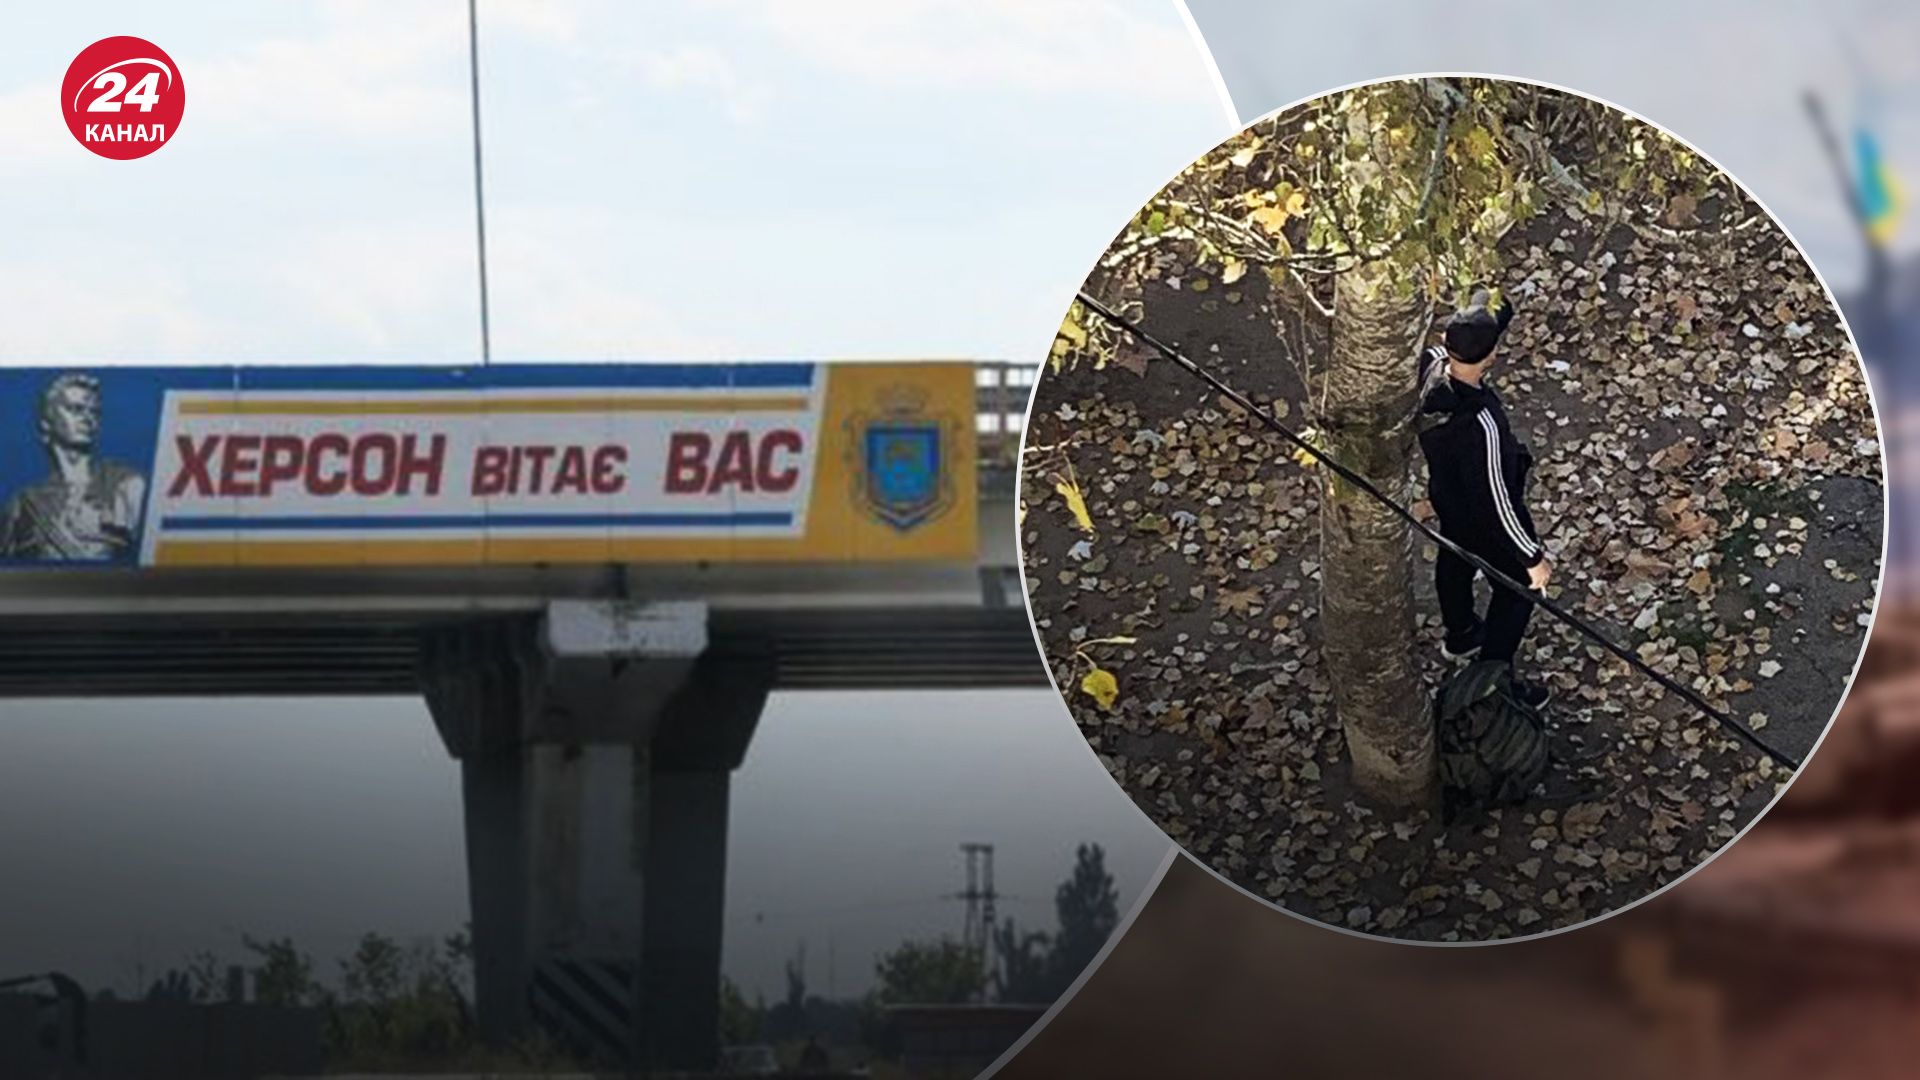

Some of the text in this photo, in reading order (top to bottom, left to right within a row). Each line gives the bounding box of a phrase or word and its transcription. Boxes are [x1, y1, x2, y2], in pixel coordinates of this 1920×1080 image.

[168, 430, 804, 497] ХЕРСОН ВІТАЄ ВАС
